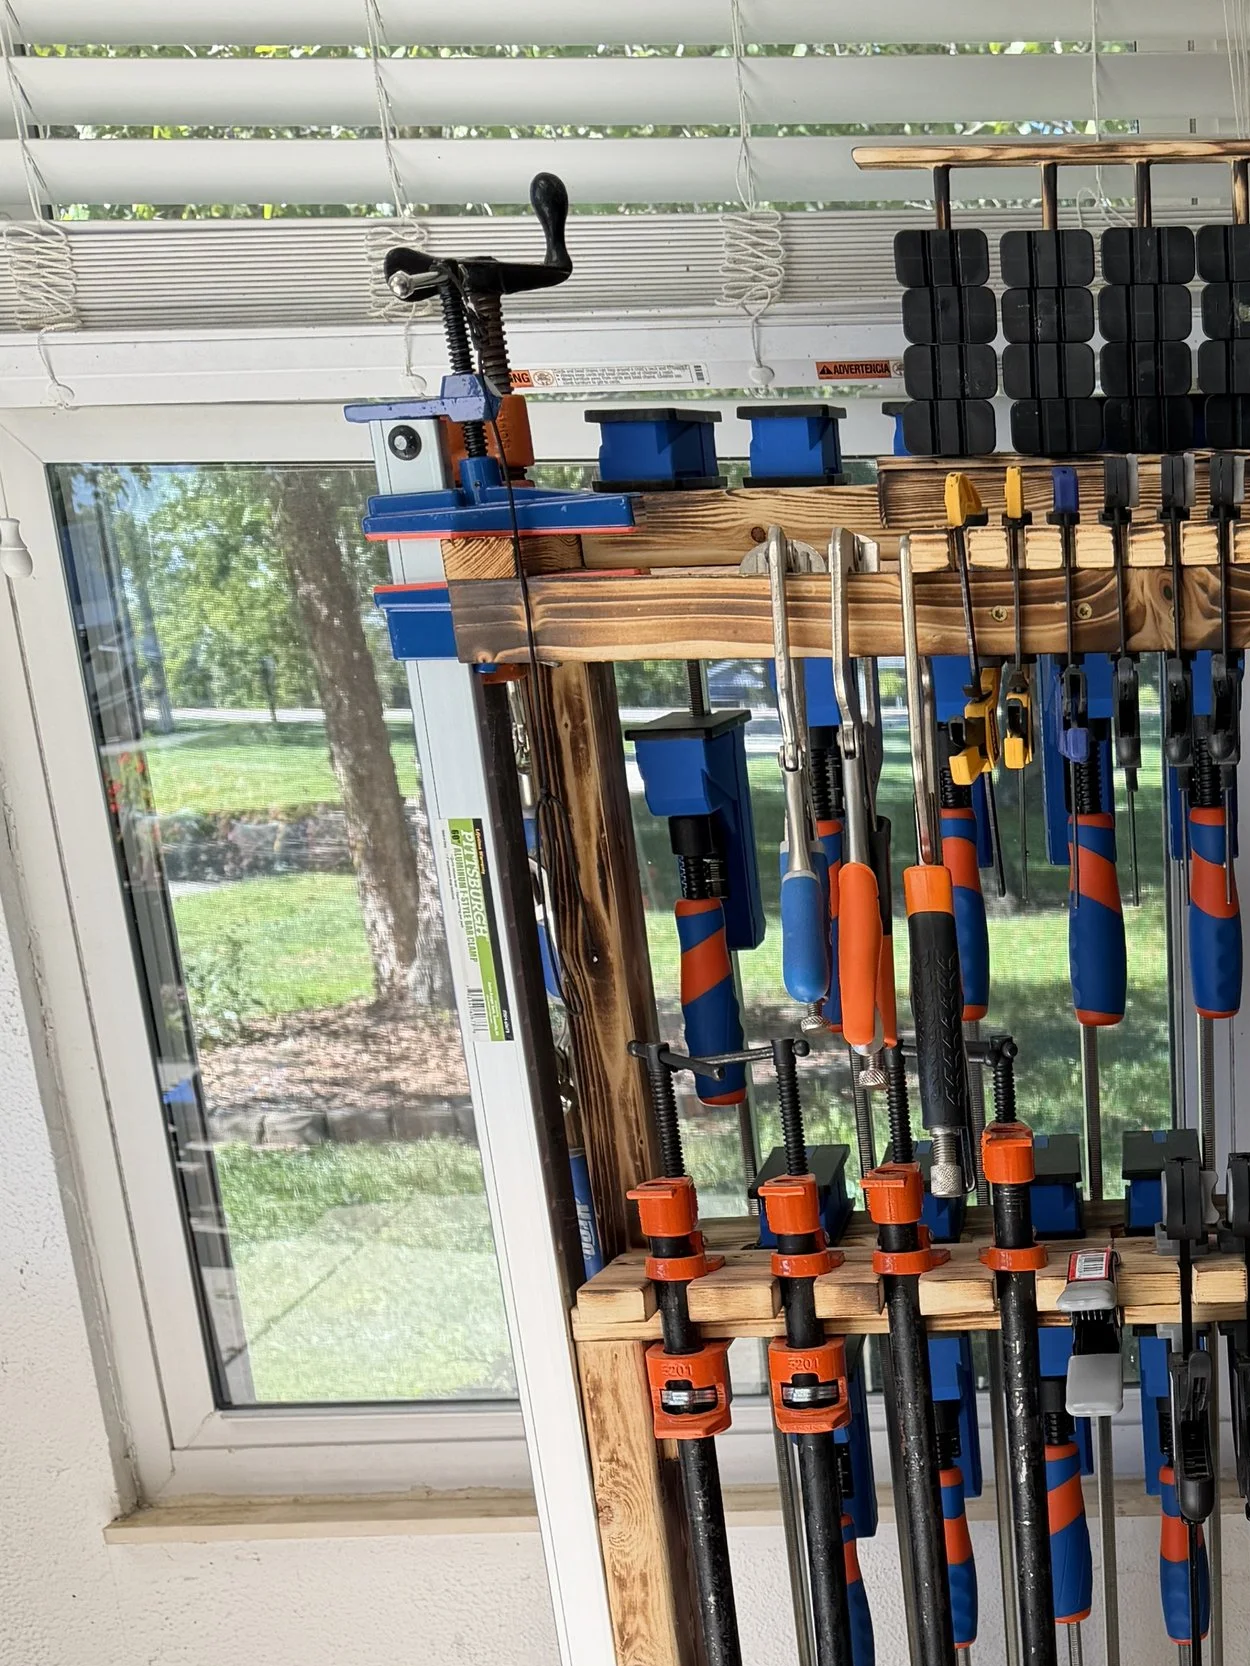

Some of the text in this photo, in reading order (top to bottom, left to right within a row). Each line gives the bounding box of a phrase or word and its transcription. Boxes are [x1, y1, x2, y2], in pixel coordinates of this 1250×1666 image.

[833, 363, 891, 375] ADVERTENCIA
[453, 847, 478, 962] ALUMINUM F-STYLE BAR CLAMP
[460, 829, 489, 941] PITTSBURGH
